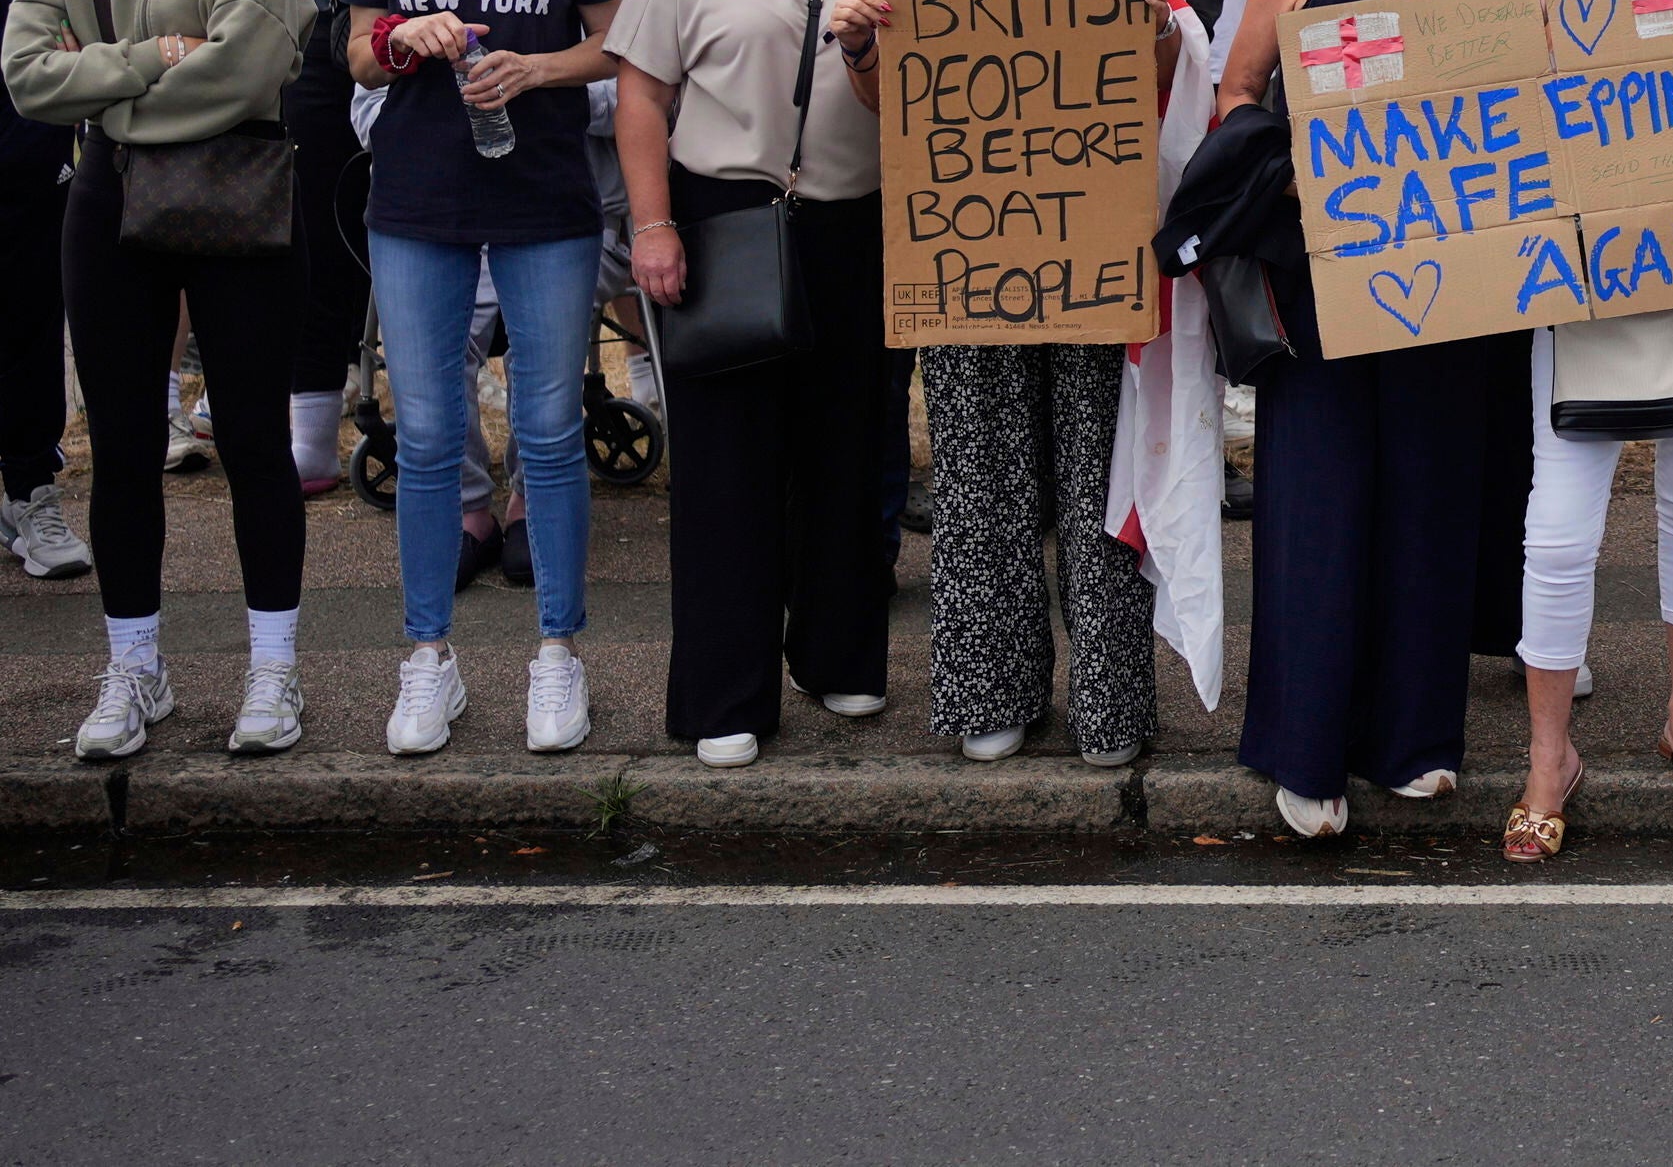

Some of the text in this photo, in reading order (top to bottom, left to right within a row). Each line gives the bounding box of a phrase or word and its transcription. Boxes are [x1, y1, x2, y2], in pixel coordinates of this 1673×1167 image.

[1415, 1, 1535, 36] WE DESERVE
[1426, 31, 1512, 67] BETTER
[898, 50, 1138, 136] PEOPLE
[926, 122, 1143, 184] BEFORE
[1309, 87, 1521, 178] MAKE
[1592, 159, 1640, 182] SEND
[907, 191, 1086, 242] BOAT
[1323, 152, 1556, 257] SAFE
[898, 291, 911, 299] UK
[933, 247, 1144, 323] PEOPLE!
[899, 319, 941, 327] EC REP
